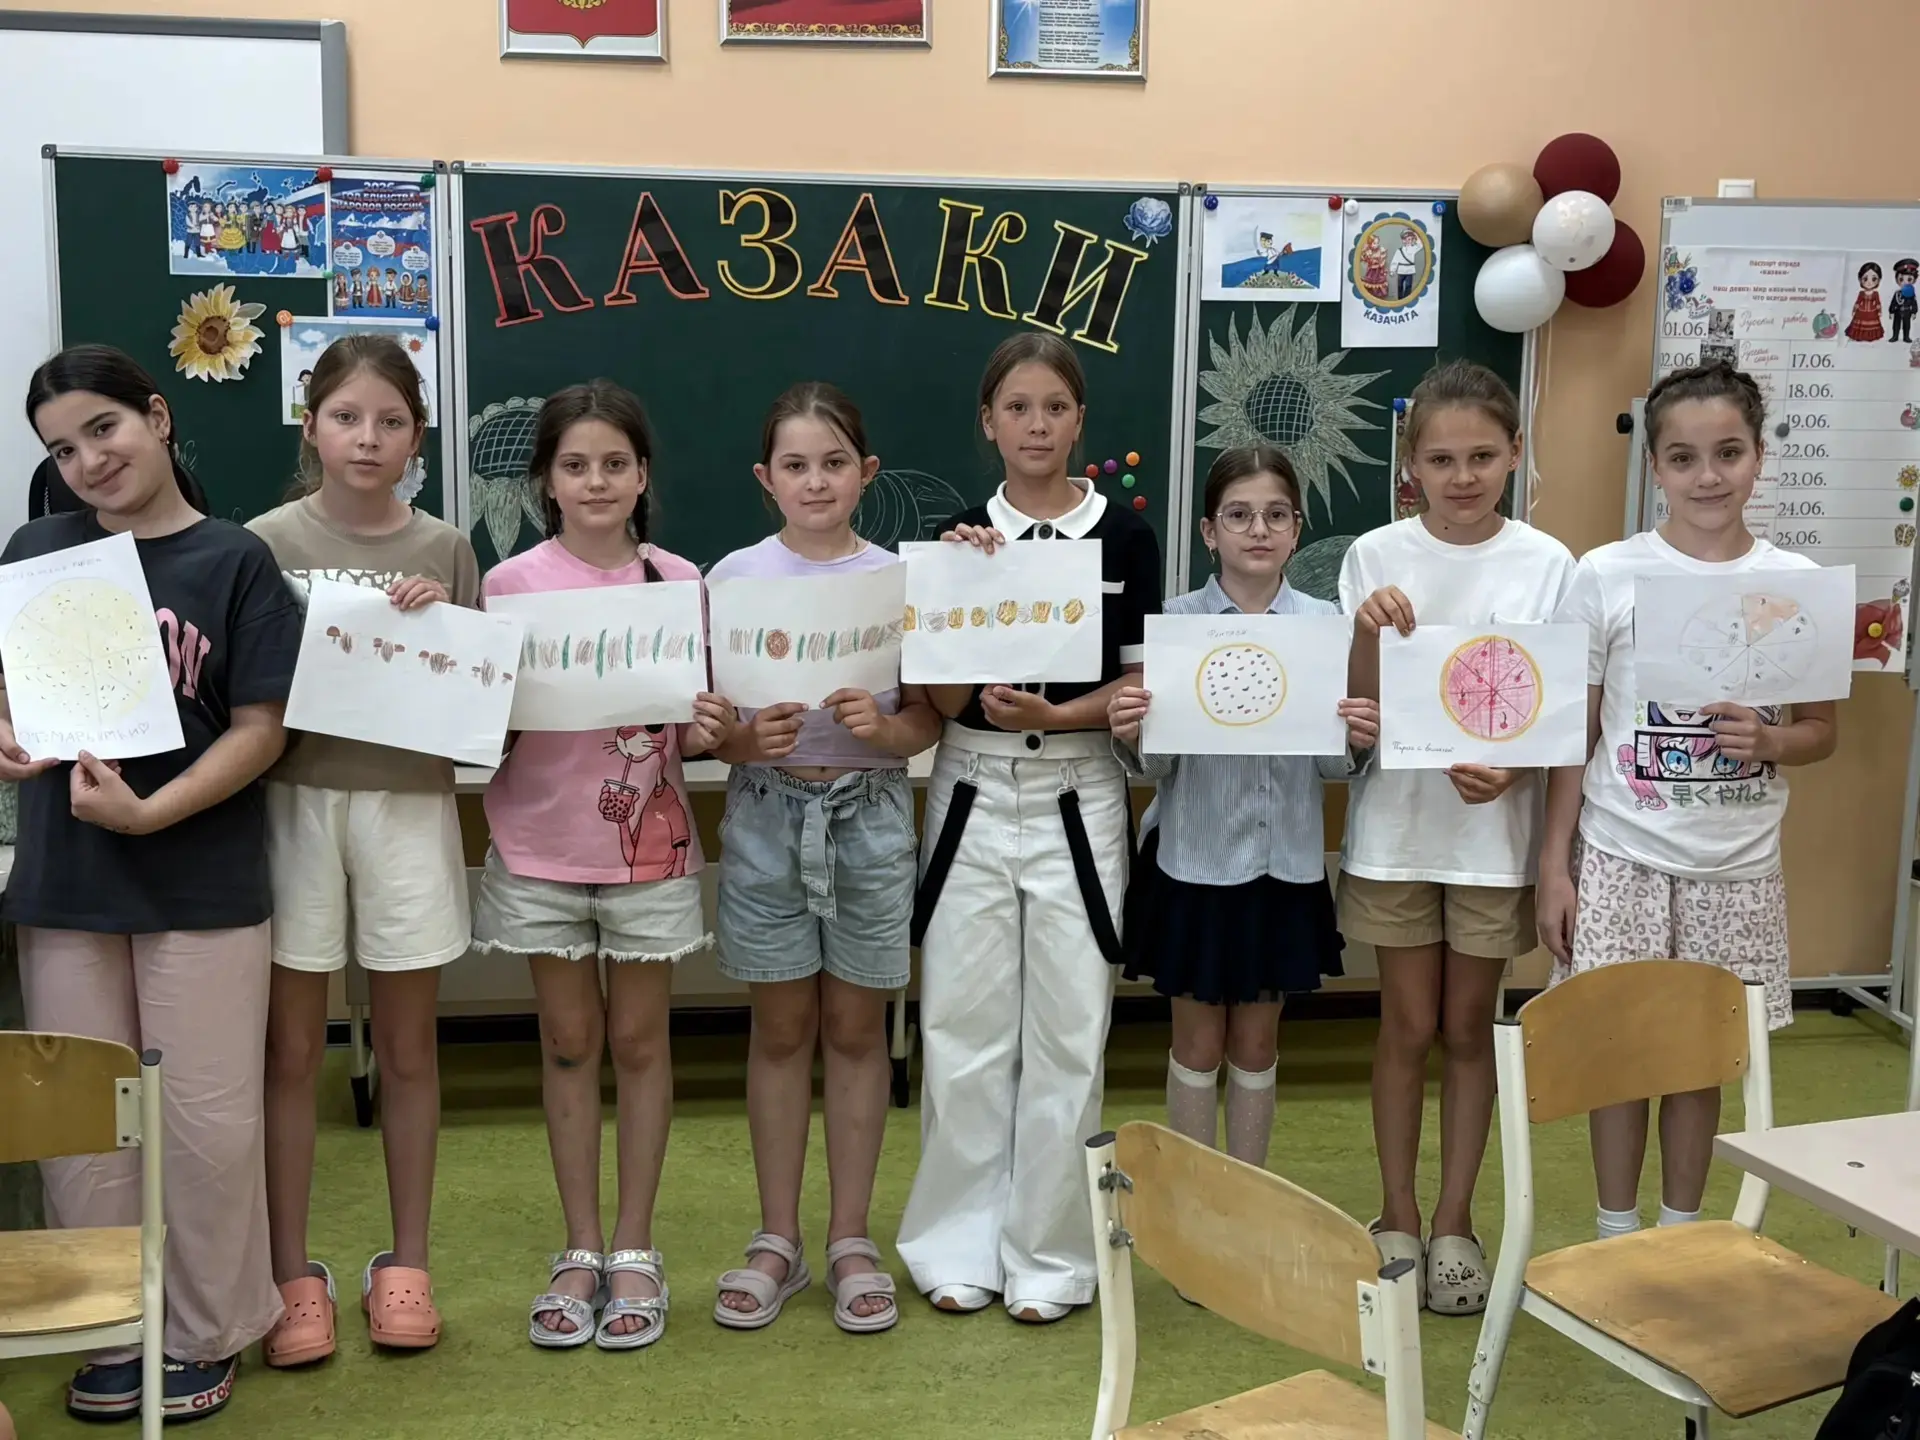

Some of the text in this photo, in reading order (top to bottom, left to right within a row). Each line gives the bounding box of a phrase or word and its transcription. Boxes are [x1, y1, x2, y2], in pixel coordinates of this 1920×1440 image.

[470, 188, 1149, 354] КАЗАКИ
[1363, 309, 1419, 325] КАЗАЧАТА
[1663, 321, 1707, 337] 01.06.
[1791, 353, 1835, 368] 17.06.
[1788, 383, 1834, 398] 18.06.
[1786, 414, 1830, 429] 19.06.
[1782, 443, 1830, 458] 22.06.
[1780, 472, 1827, 487] 23.06.
[1777, 501, 1825, 516] 24.06.
[1775, 530, 1822, 546] 25.06.
[1670, 779, 1767, 807] 早くやれよ
